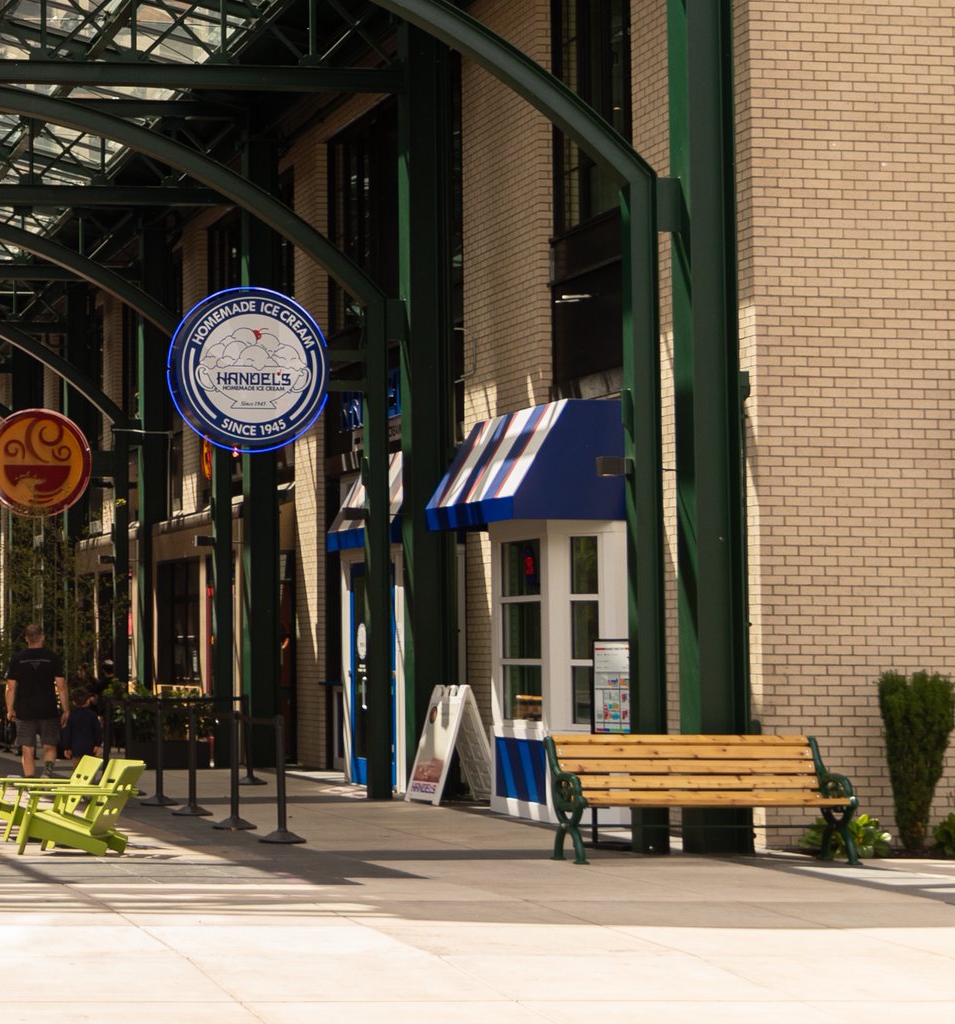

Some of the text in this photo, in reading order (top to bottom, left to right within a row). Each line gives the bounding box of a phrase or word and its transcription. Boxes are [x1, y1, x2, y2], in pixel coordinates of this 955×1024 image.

[192, 301, 315, 349] HOMEMADE ICE CREAM
[216, 370, 292, 386] HANDEL'S
[221, 418, 287, 436] SINCE 1945
